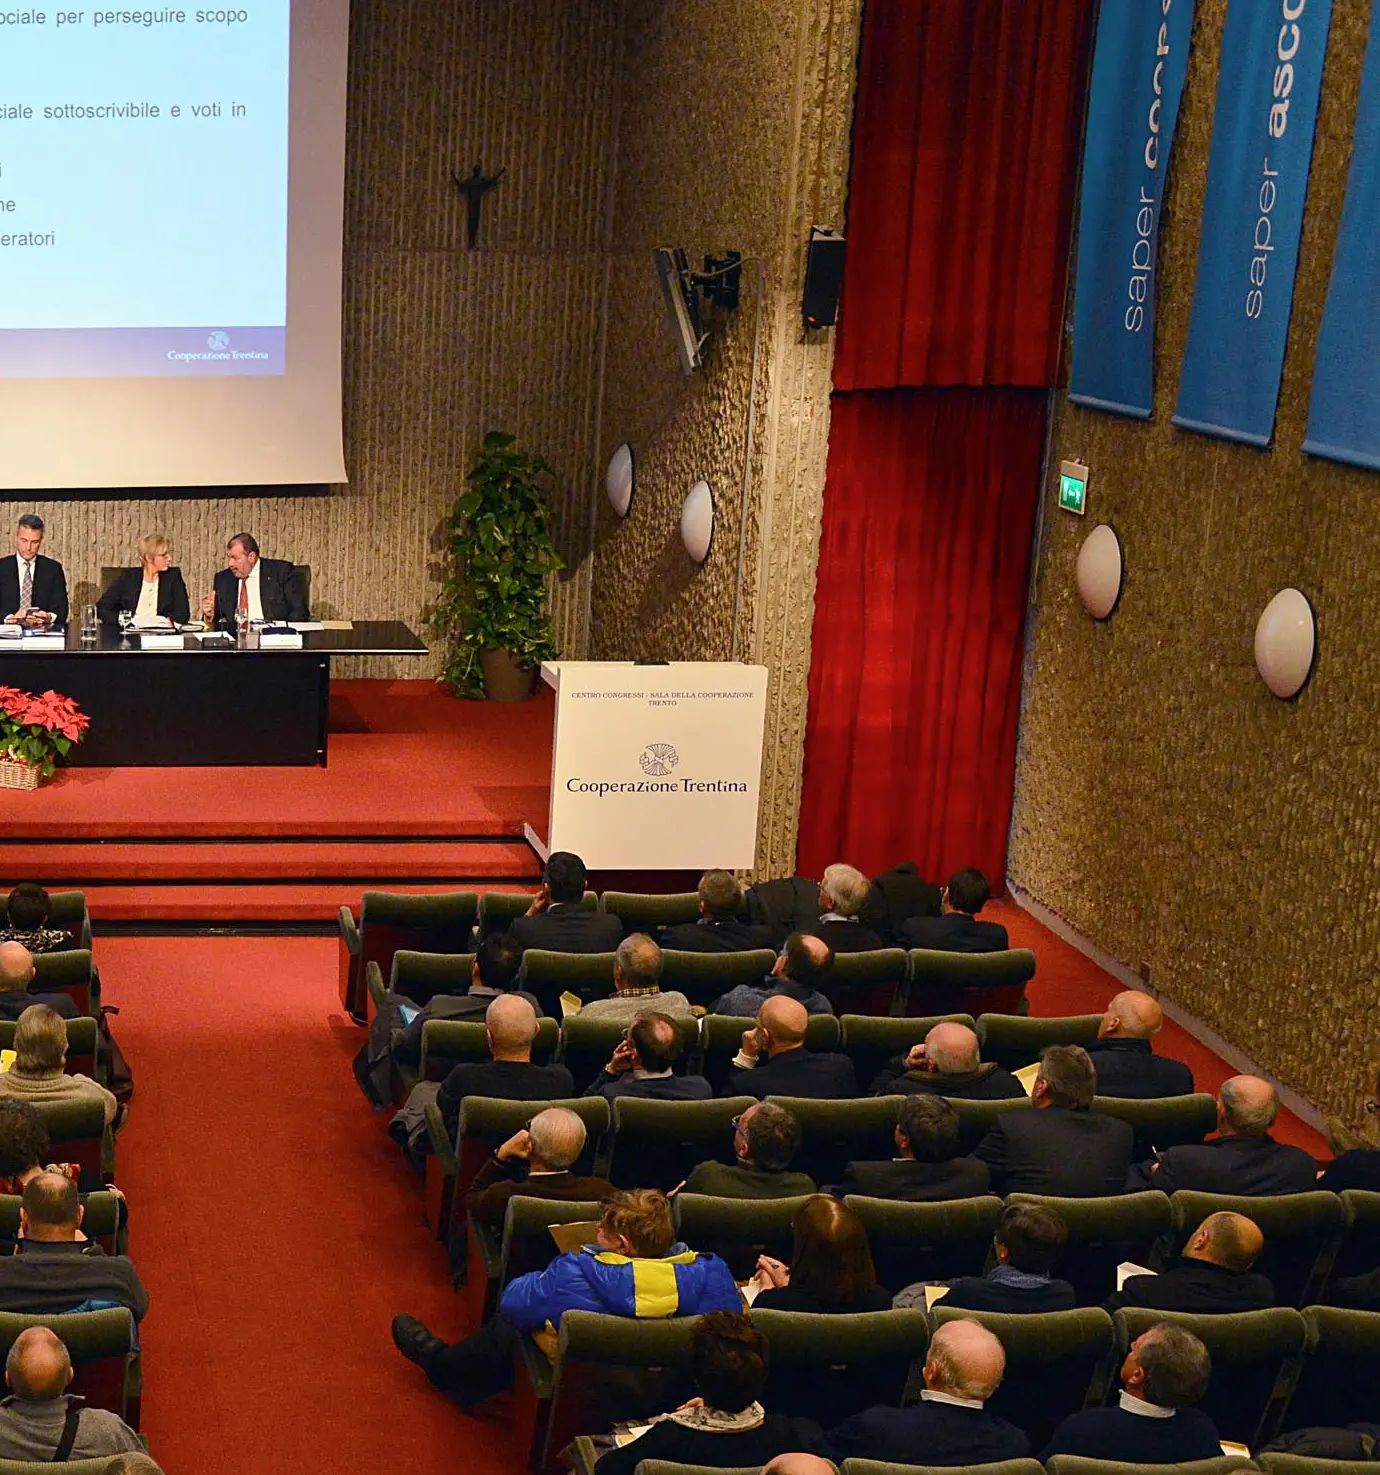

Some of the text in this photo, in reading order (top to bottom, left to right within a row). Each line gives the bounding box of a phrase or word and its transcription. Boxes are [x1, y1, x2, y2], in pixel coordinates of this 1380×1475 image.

[55, 11, 85, 29] per
[93, 7, 187, 28] perseguire
[195, 9, 248, 27] scopo
[43, 101, 161, 119] sottoscrivibile
[170, 105, 181, 118] e
[190, 101, 221, 118] voti
[231, 101, 247, 117] in
[1245, 157, 1280, 319] saper
[1124, 185, 1156, 333] saper
[166, 350, 269, 363] Cooperazione Trentina
[566, 778, 747, 797] Cooperazione Trentina
